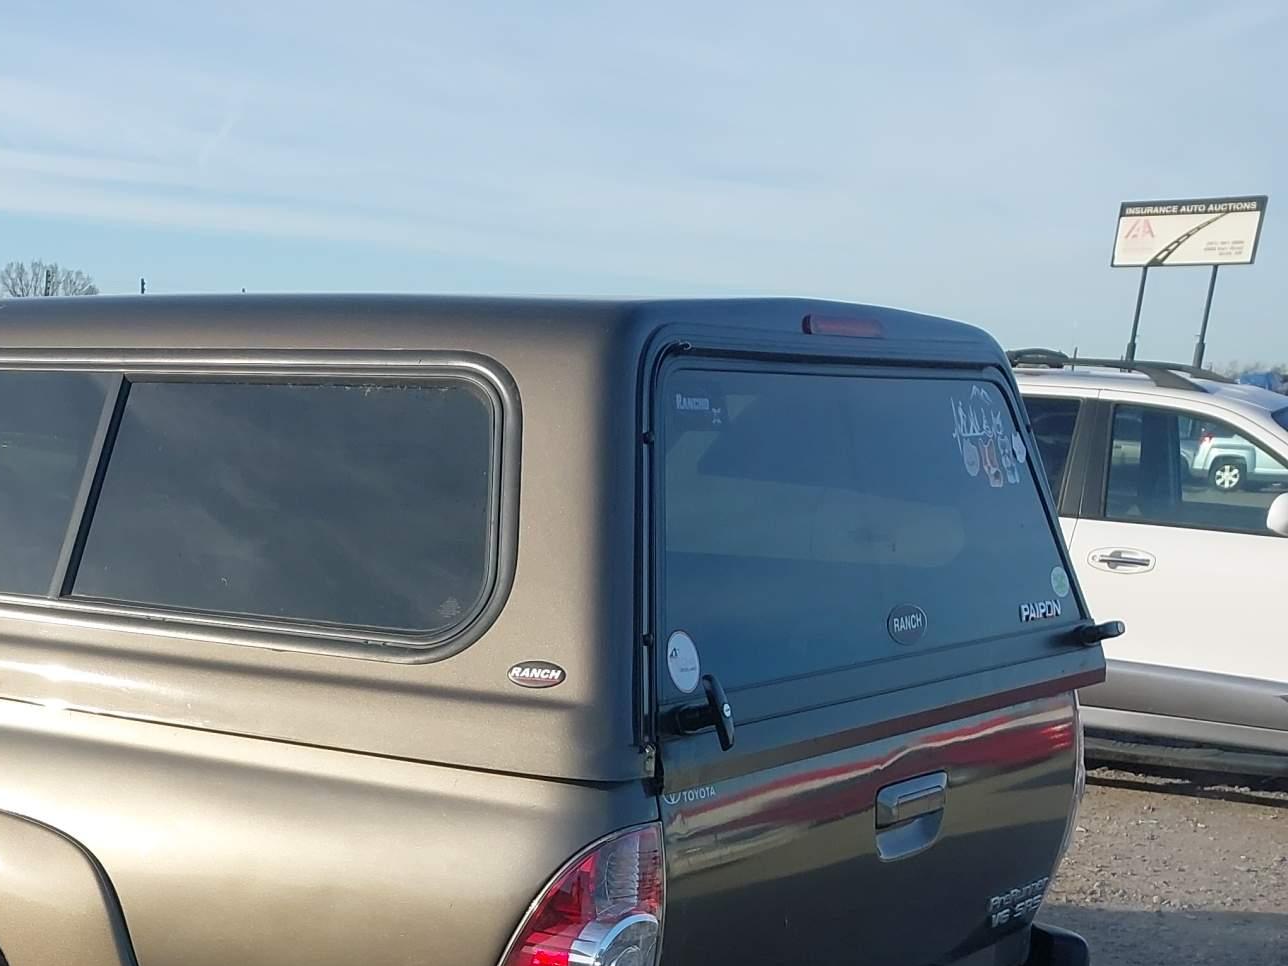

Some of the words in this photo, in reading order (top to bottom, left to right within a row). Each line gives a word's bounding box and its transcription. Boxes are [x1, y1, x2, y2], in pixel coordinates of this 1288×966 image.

[1125, 205, 1178, 215] INSURANCE
[1180, 204, 1206, 213] AUTO
[1207, 201, 1258, 212] AUCTIONS
[893, 613, 923, 633] RANCH
[510, 666, 562, 680] RANCH
[682, 786, 717, 802] TOYOTA
